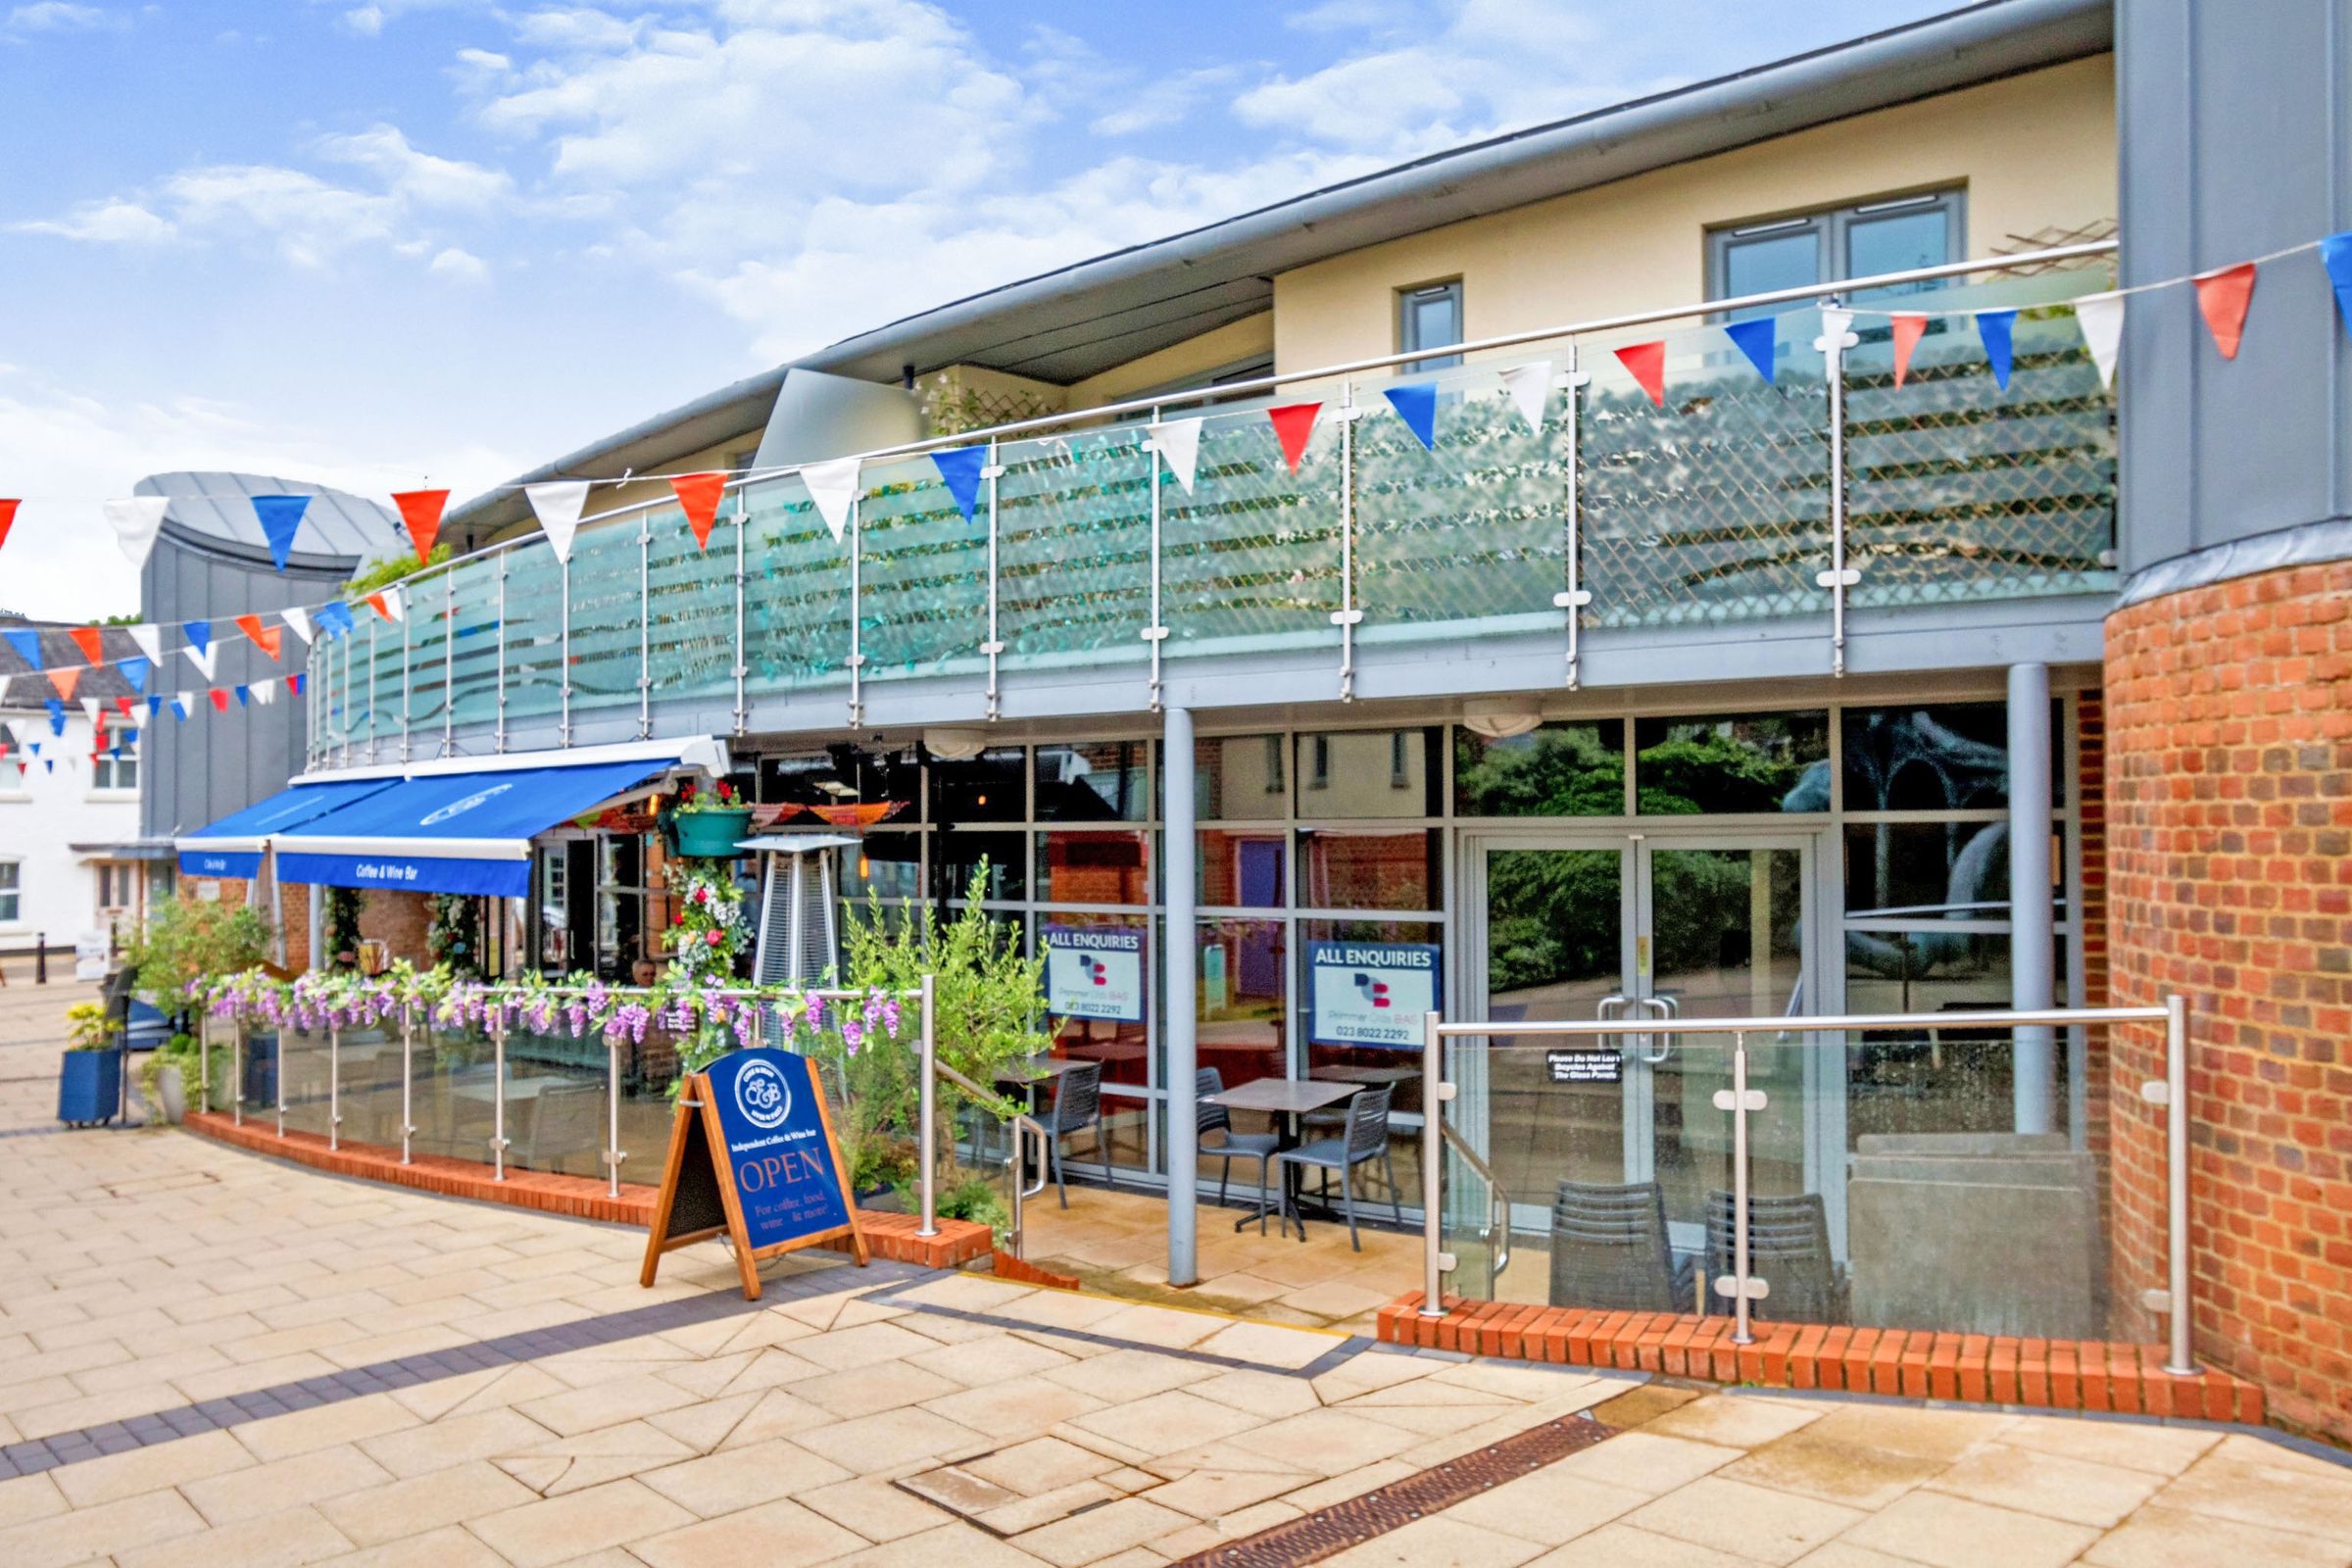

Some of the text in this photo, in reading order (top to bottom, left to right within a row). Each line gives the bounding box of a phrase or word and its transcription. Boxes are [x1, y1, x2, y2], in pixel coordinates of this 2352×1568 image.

[356, 864, 417, 880] Coffee & Wine Bar
[1050, 932, 1139, 950] ALL ENQUIRIES
[1315, 948, 1432, 967] ALL ENQUIRIES
[1101, 1004, 1121, 1014] 2292
[1336, 1025, 1410, 1040] 023 8022 2292
[765, 1135, 784, 1145] Coffee
[790, 1131, 806, 1140] Wine
[740, 1147, 823, 1193] OPEN
[755, 1205, 771, 1216] For
